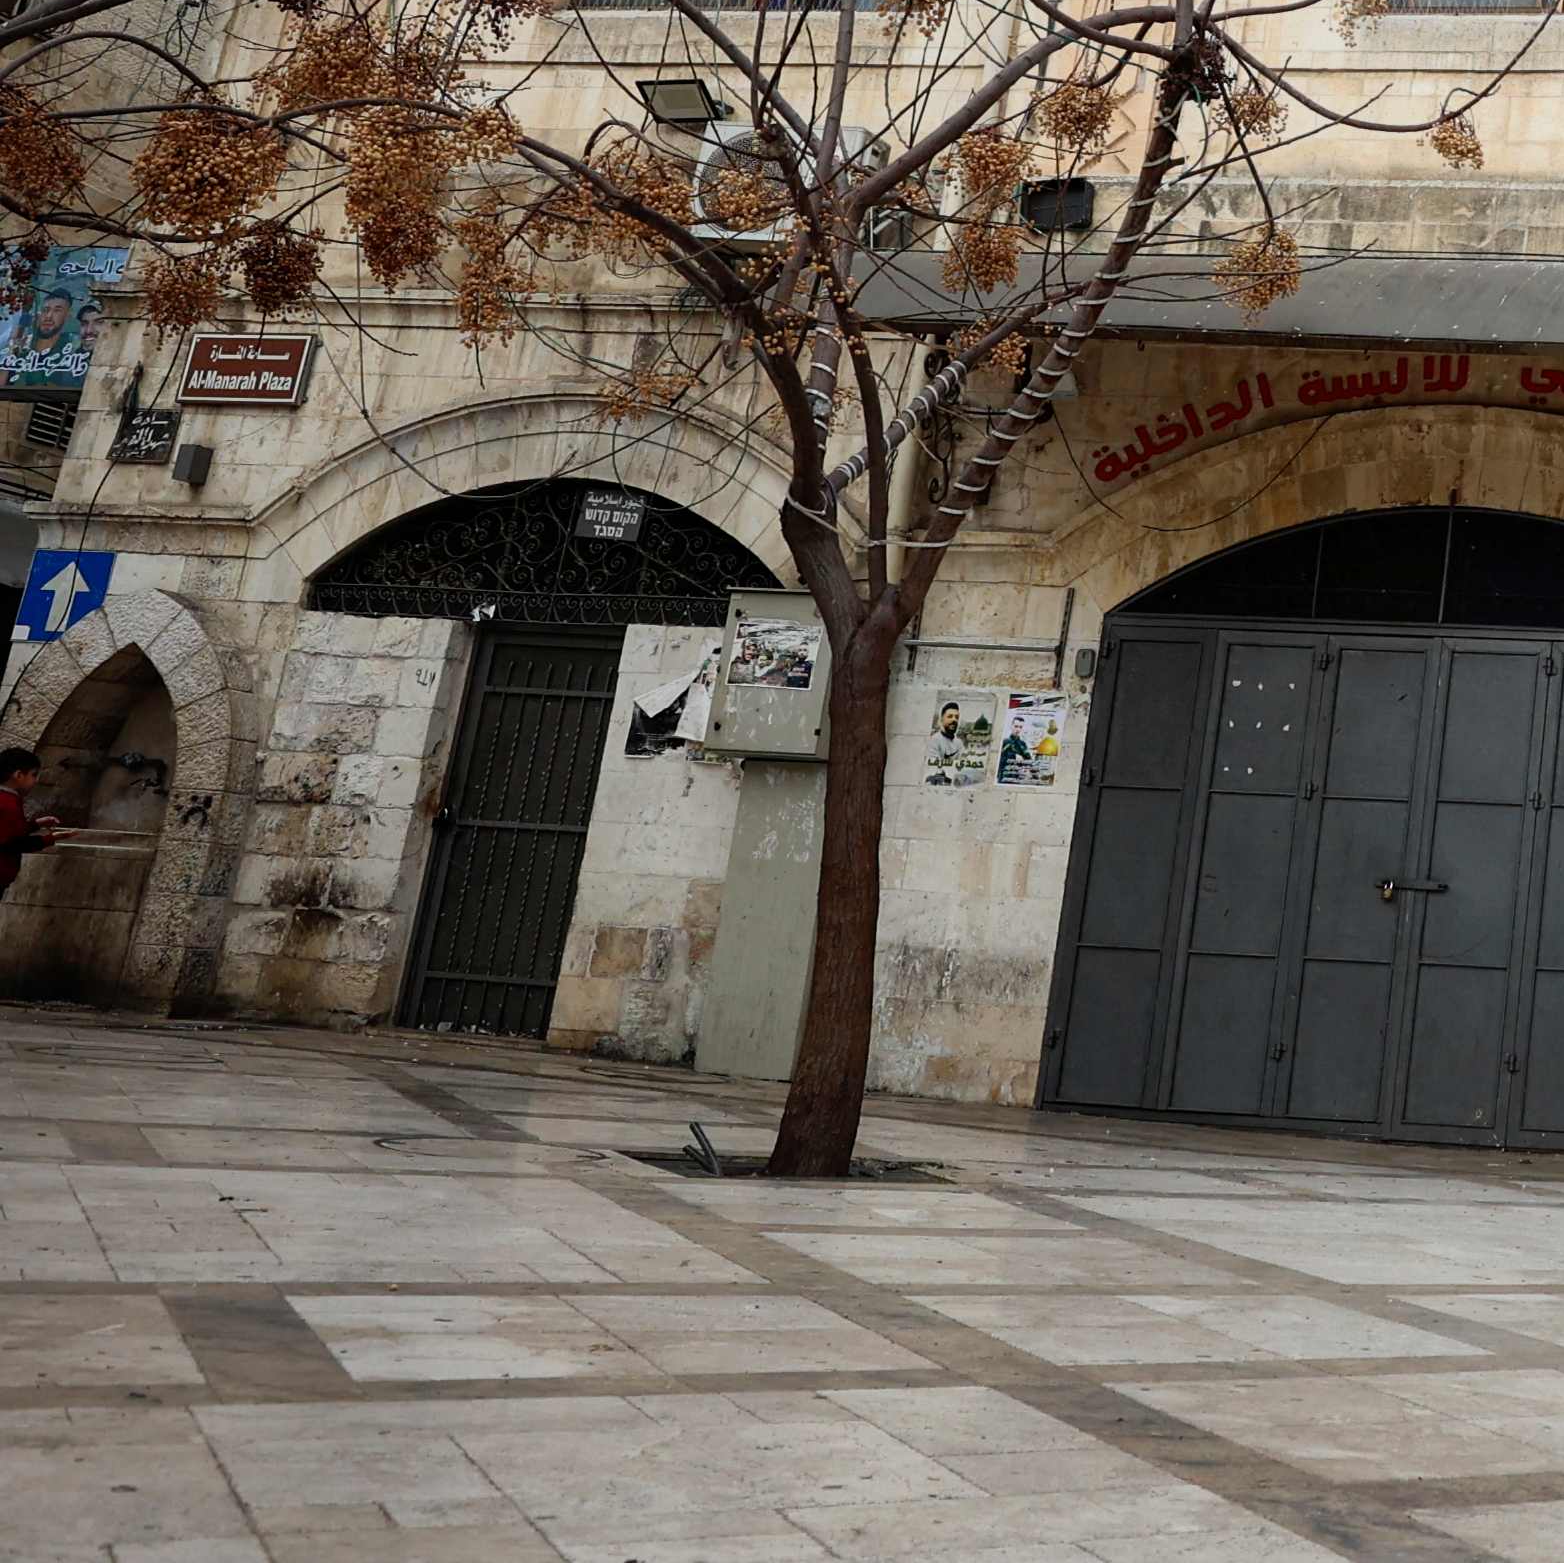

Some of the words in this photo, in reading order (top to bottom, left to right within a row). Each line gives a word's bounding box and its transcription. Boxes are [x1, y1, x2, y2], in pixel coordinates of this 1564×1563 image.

[187, 369, 257, 390] Al-Manarah
[257, 371, 293, 391] Plaza
[1094, 372, 1275, 482] الداخلية
[585, 508, 611, 524] קדוש
